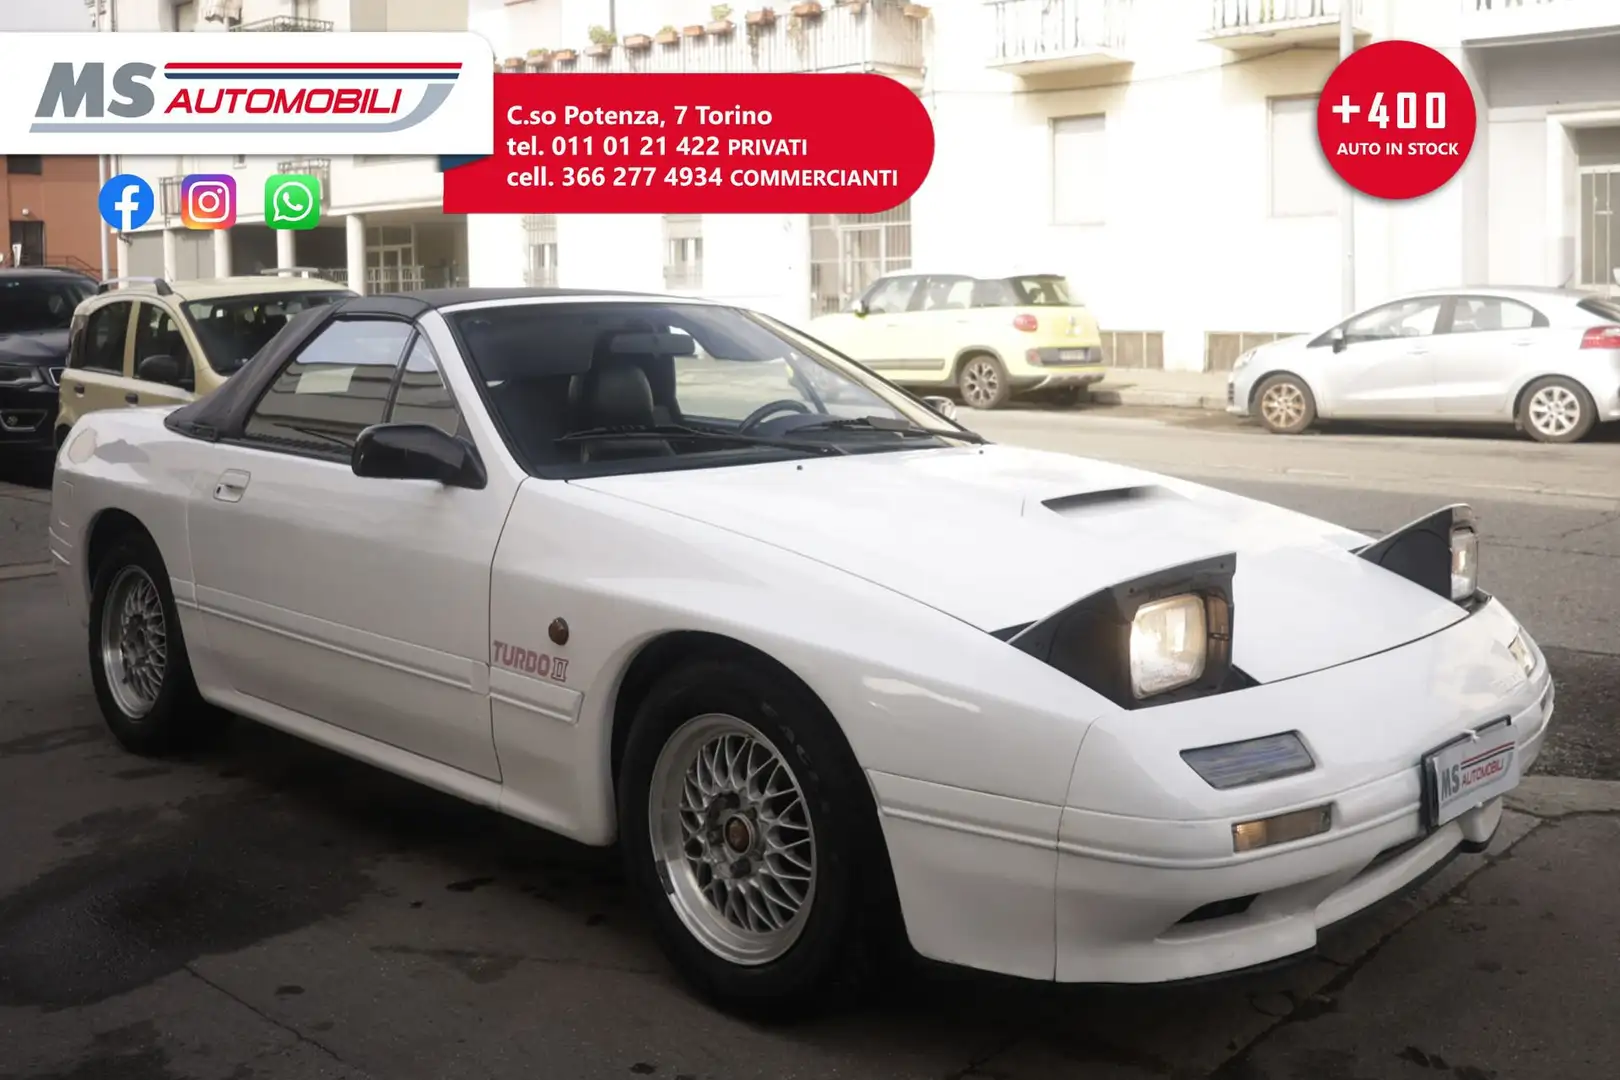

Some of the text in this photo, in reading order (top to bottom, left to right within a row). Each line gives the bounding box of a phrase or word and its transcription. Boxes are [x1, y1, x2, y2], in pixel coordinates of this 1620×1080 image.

[493, 640, 550, 677] TURBO
[1441, 758, 1505, 801] MS AUTOMOBILI
